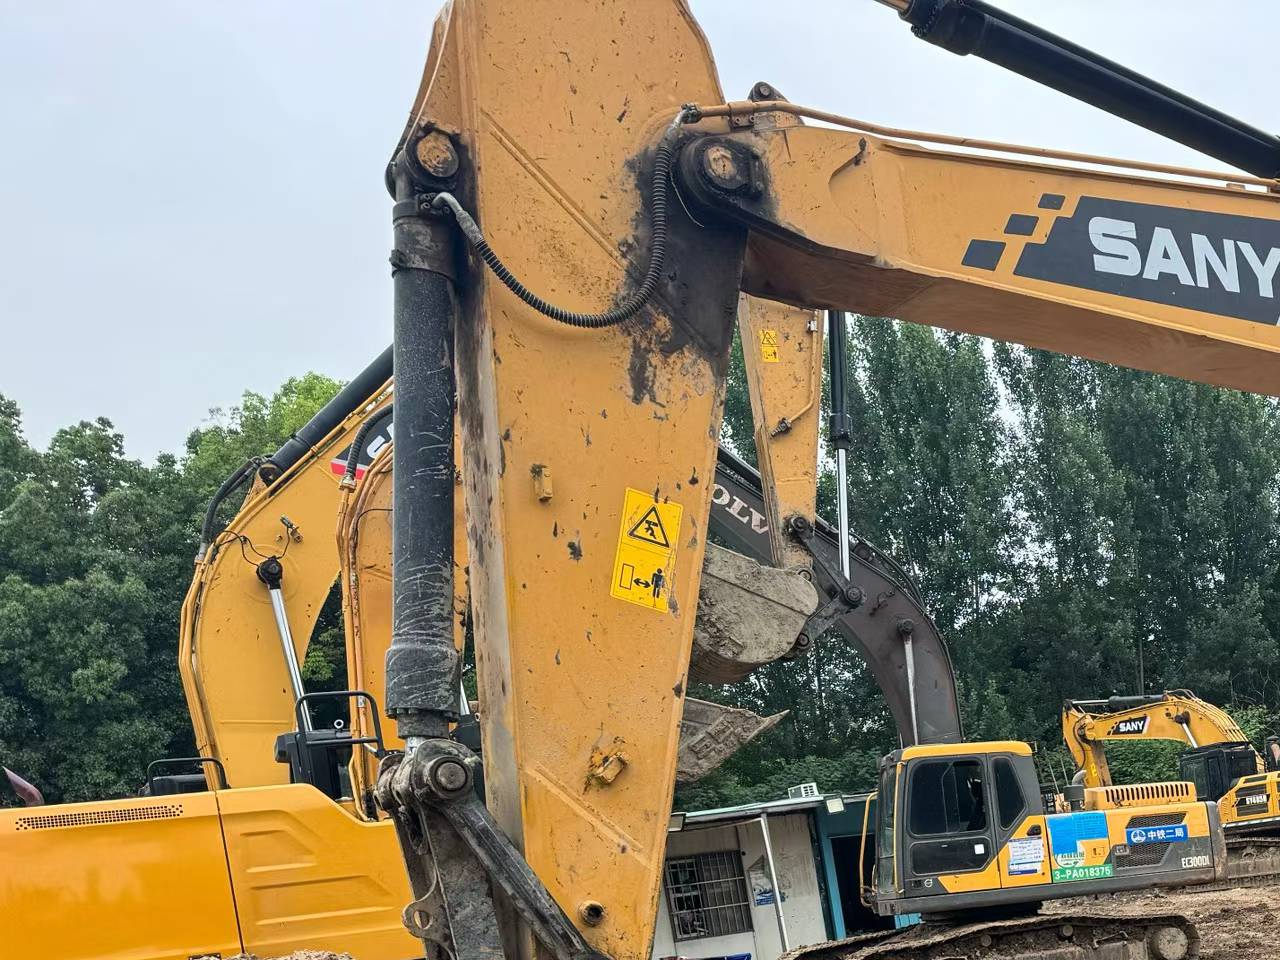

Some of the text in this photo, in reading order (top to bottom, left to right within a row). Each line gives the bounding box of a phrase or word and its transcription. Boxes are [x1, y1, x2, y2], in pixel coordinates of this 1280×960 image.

[711, 483, 769, 534] OLV
[1119, 720, 1144, 732] SANY
[1147, 827, 1185, 840] 中铁二局
[1055, 866, 1111, 880] 3-PA018375
